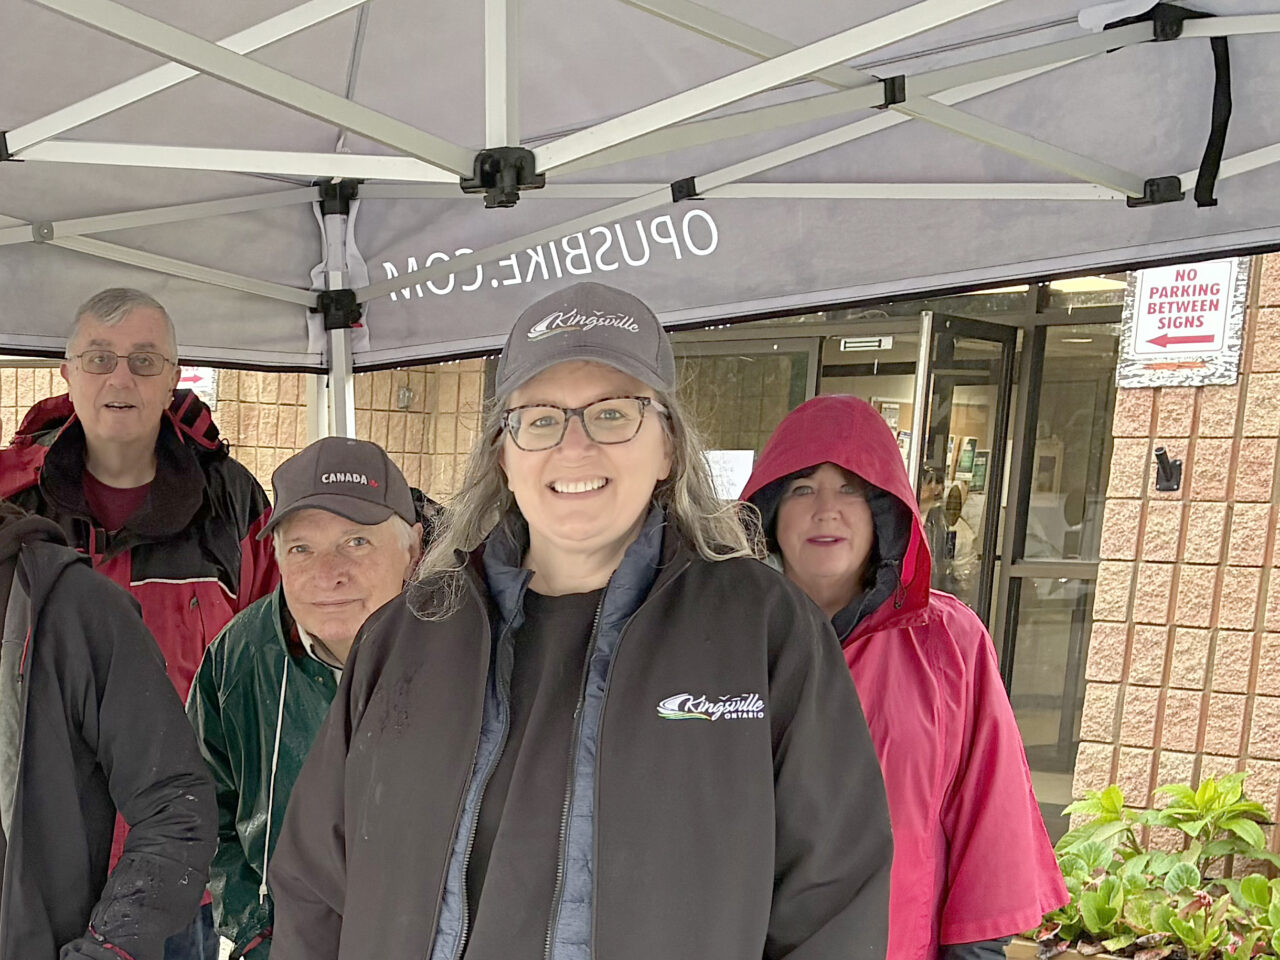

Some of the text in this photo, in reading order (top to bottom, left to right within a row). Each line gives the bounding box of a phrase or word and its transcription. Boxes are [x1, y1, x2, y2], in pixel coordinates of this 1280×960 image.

[1174, 268, 1198, 283] NO
[1149, 282, 1221, 300] PARKING
[1147, 298, 1220, 315] BETWEEN
[553, 308, 640, 334] Kingsville
[1157, 314, 1205, 330] SIGNS
[321, 472, 368, 485] CANADA
[684, 693, 765, 721] Kingsville
